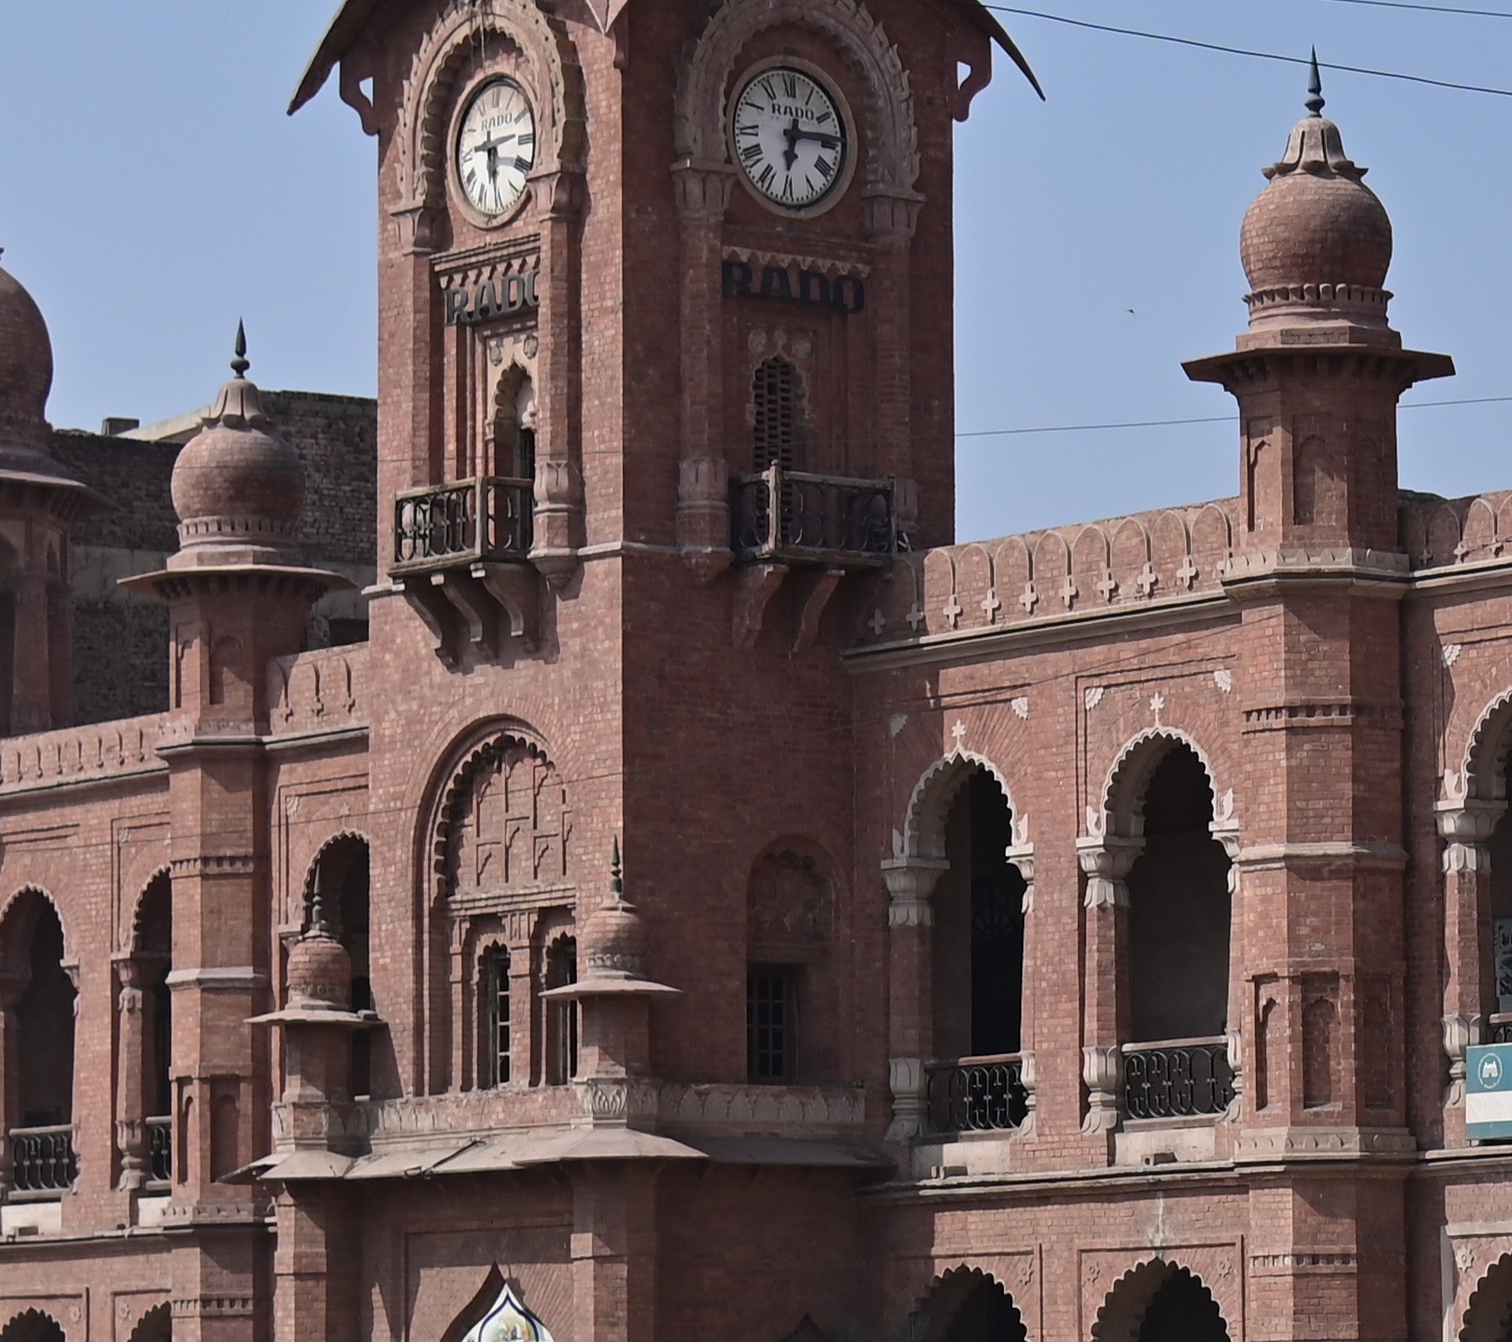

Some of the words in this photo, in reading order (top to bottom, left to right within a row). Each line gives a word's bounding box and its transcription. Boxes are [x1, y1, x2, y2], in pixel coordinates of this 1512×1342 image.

[771, 103, 814, 120] RADO
[481, 112, 513, 131] RADO
[721, 260, 864, 314] RADO
